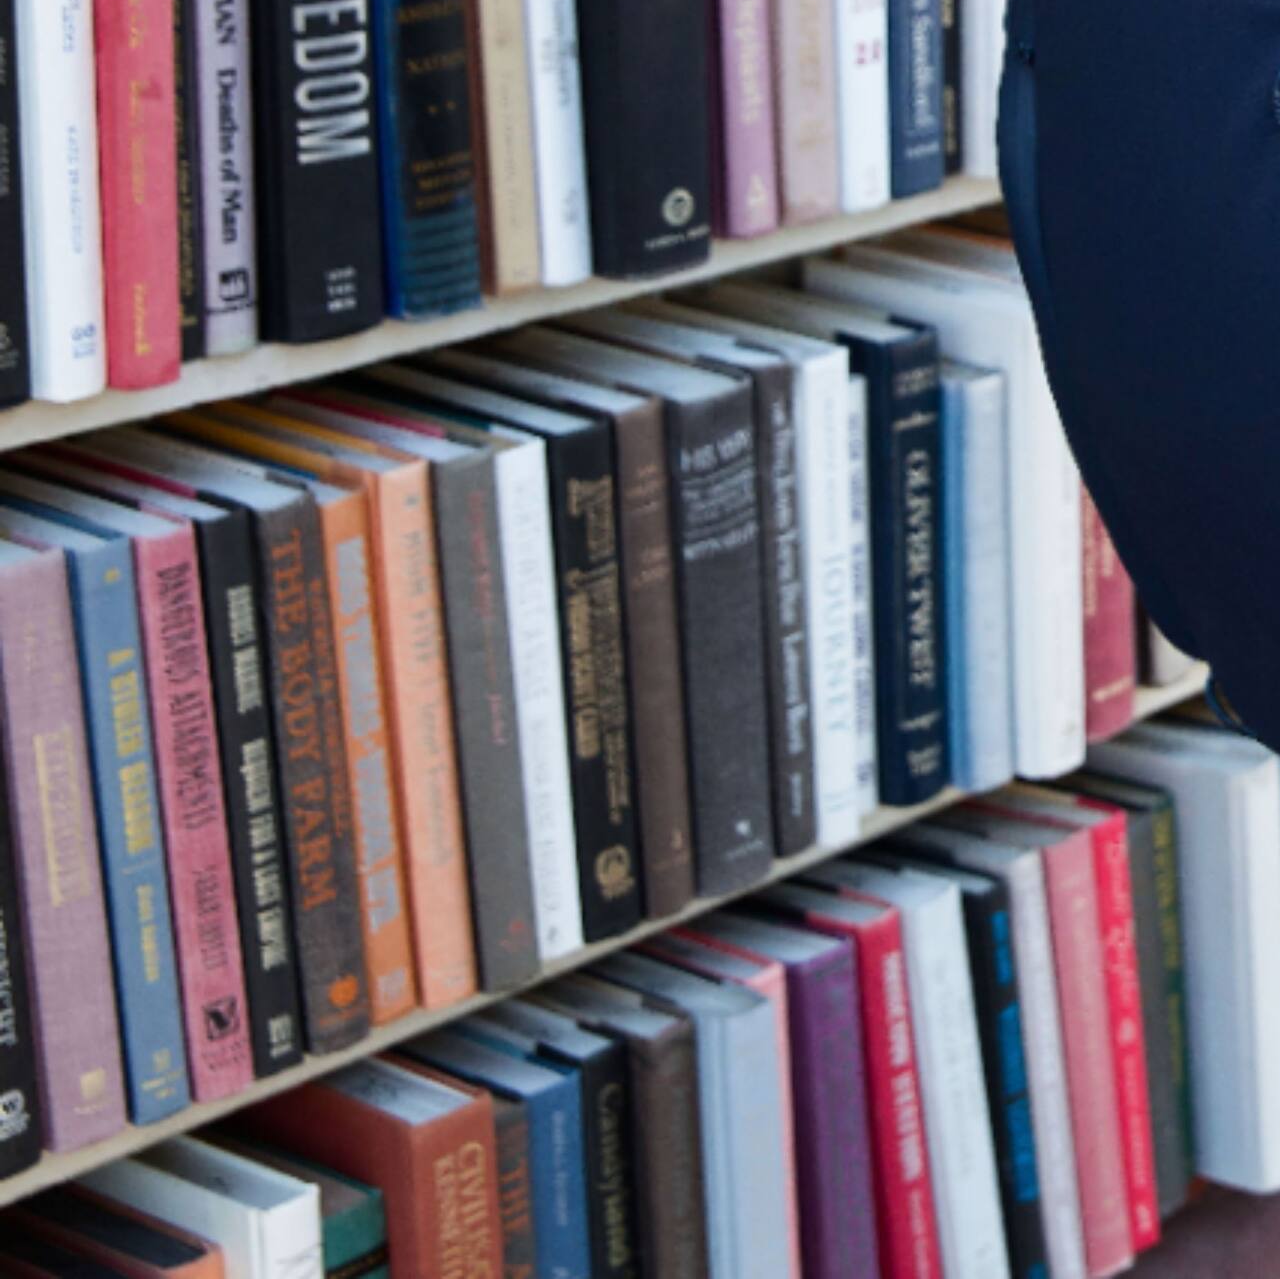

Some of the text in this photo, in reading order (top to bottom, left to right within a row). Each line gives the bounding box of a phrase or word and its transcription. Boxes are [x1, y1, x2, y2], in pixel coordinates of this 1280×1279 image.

[216, 67, 239, 154] Deaths
[219, 158, 241, 183] of
[221, 189, 243, 244] Man
[156, 561, 201, 685] DANGEROUS
[905, 449, 936, 688] OLIVER TWIST
[821, 552, 851, 736] JOURNEY
[110, 670, 145, 759] STOLEN
[271, 528, 337, 912] THE BODY FARM
[118, 761, 156, 855] SEASON
[598, 1084, 629, 1267] Candyland
